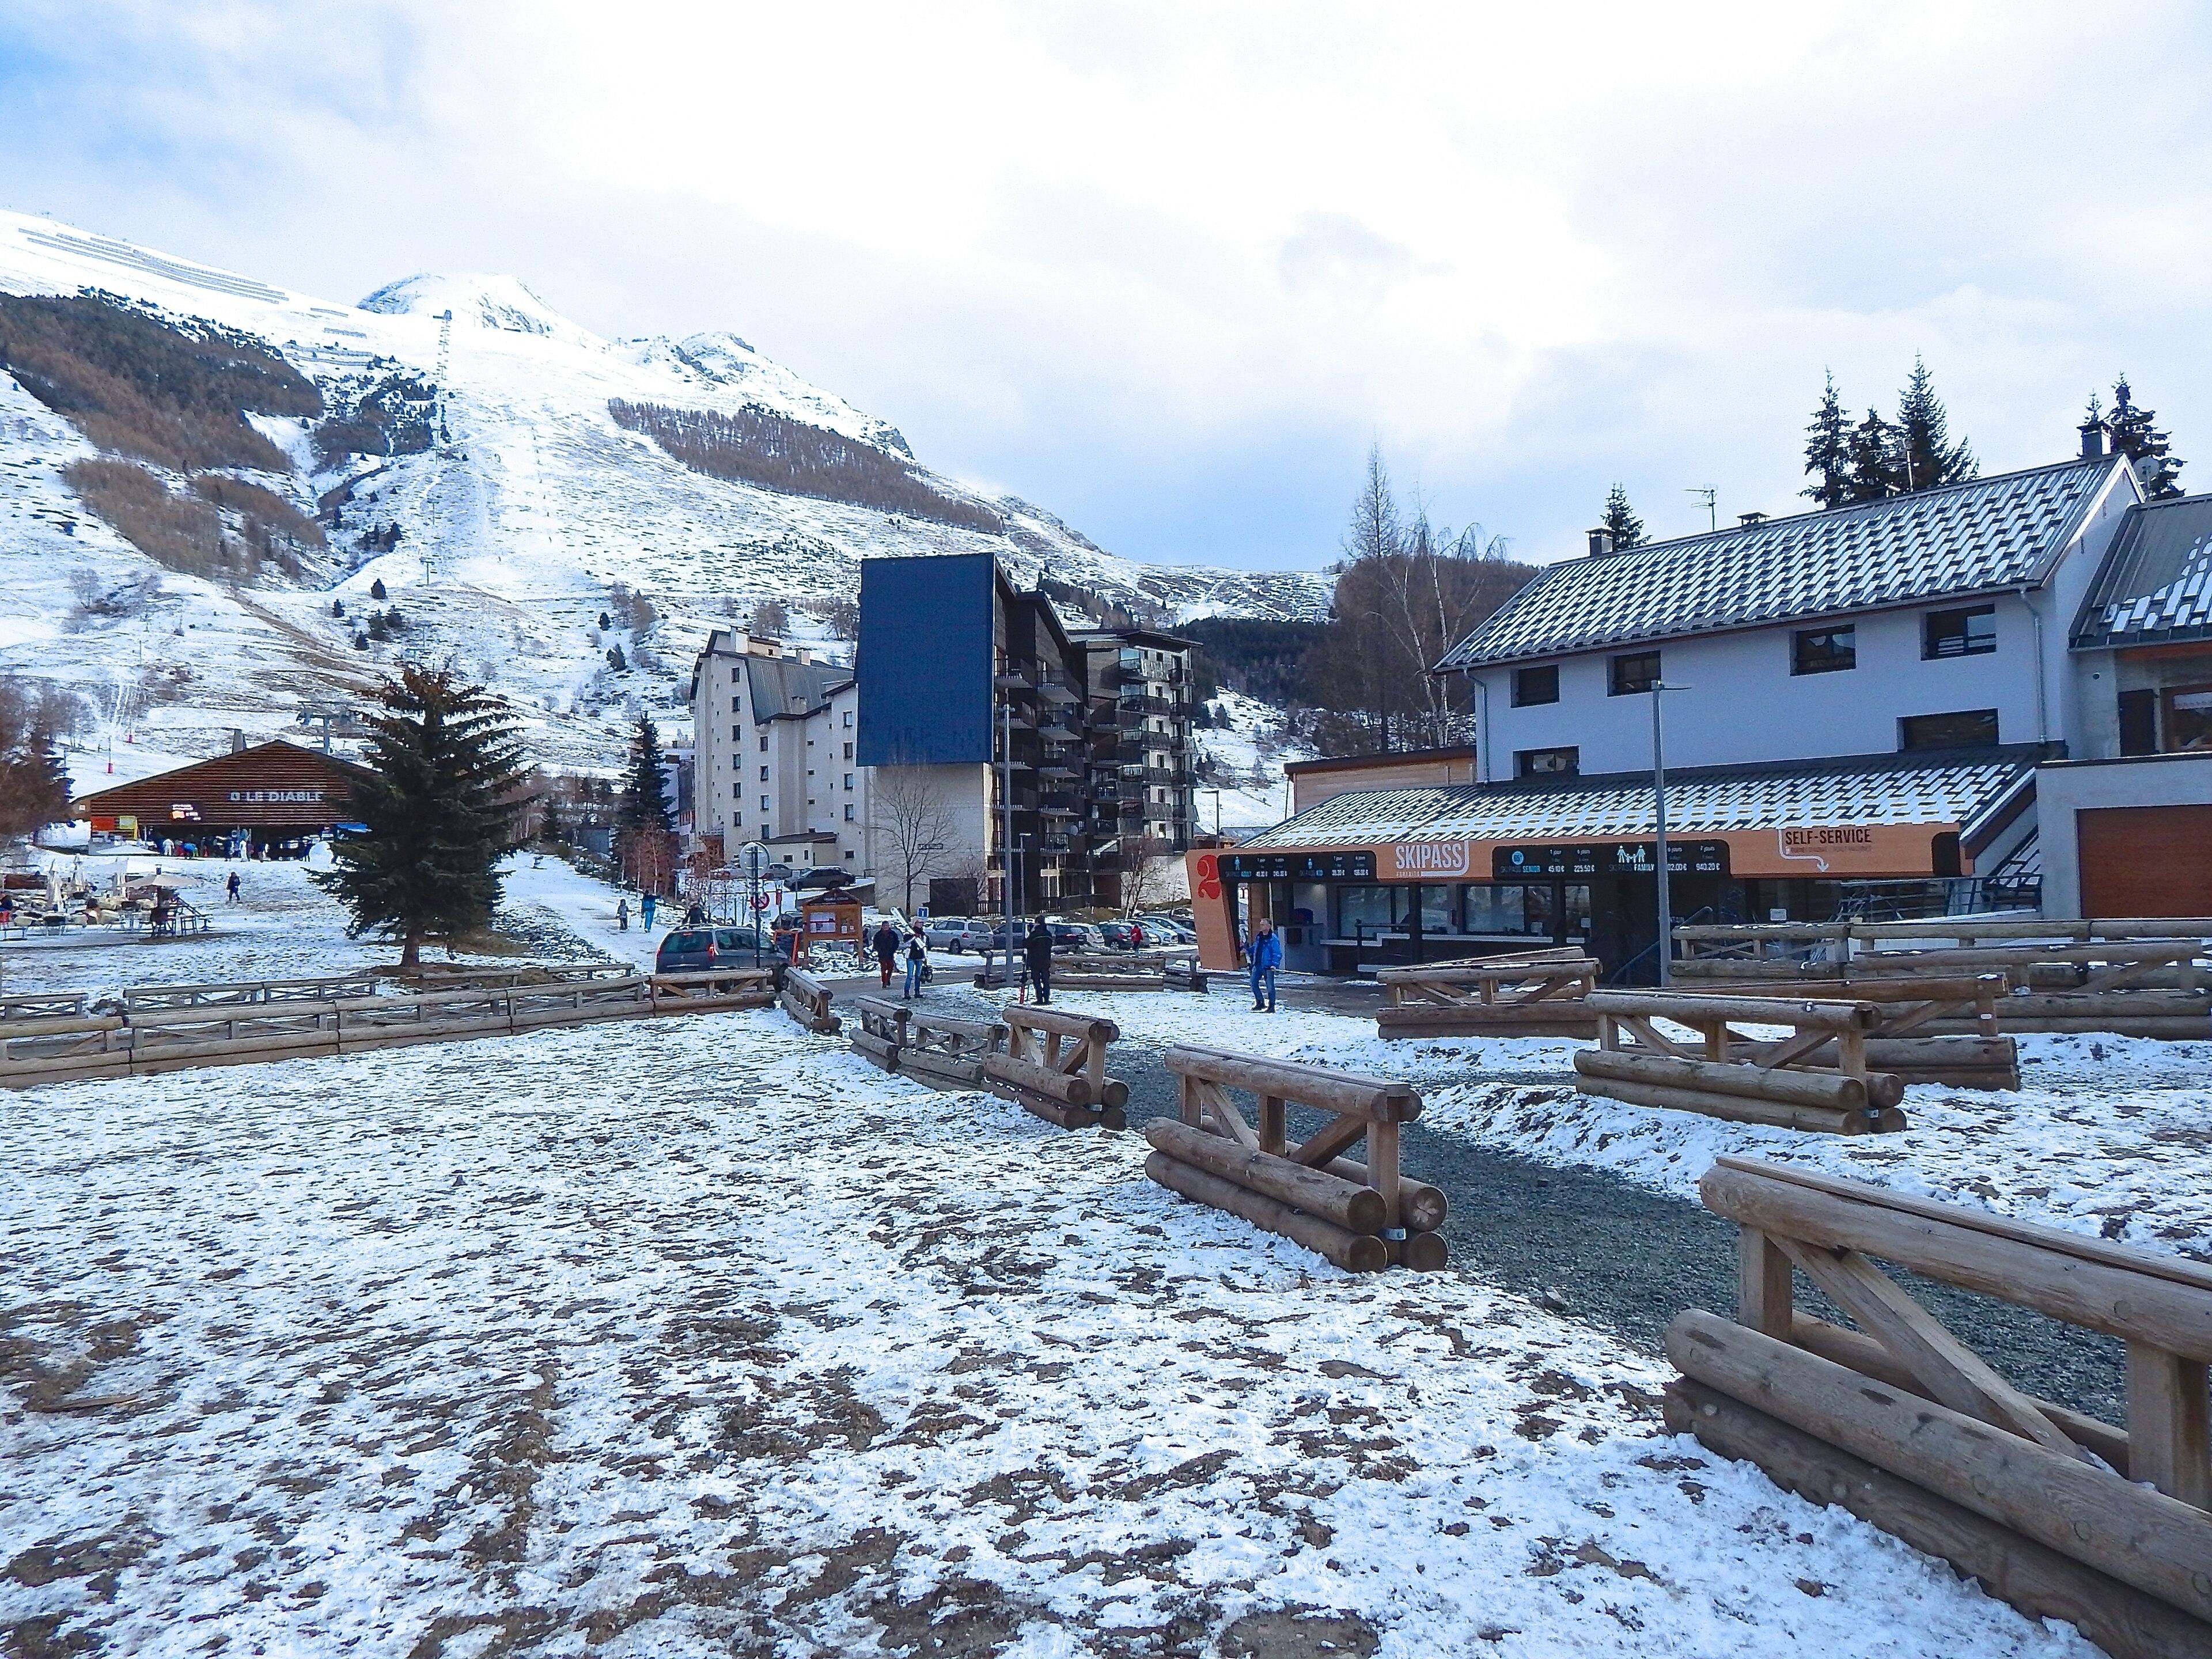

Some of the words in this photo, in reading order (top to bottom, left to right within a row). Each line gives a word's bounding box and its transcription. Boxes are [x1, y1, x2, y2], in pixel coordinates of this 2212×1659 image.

[247, 792, 263, 801] LE
[269, 792, 323, 801] DIABLE
[1786, 829, 1871, 844] SELF-SERVICE
[1396, 843, 1462, 869] SKIPASS
[1198, 855, 1221, 899] 2
